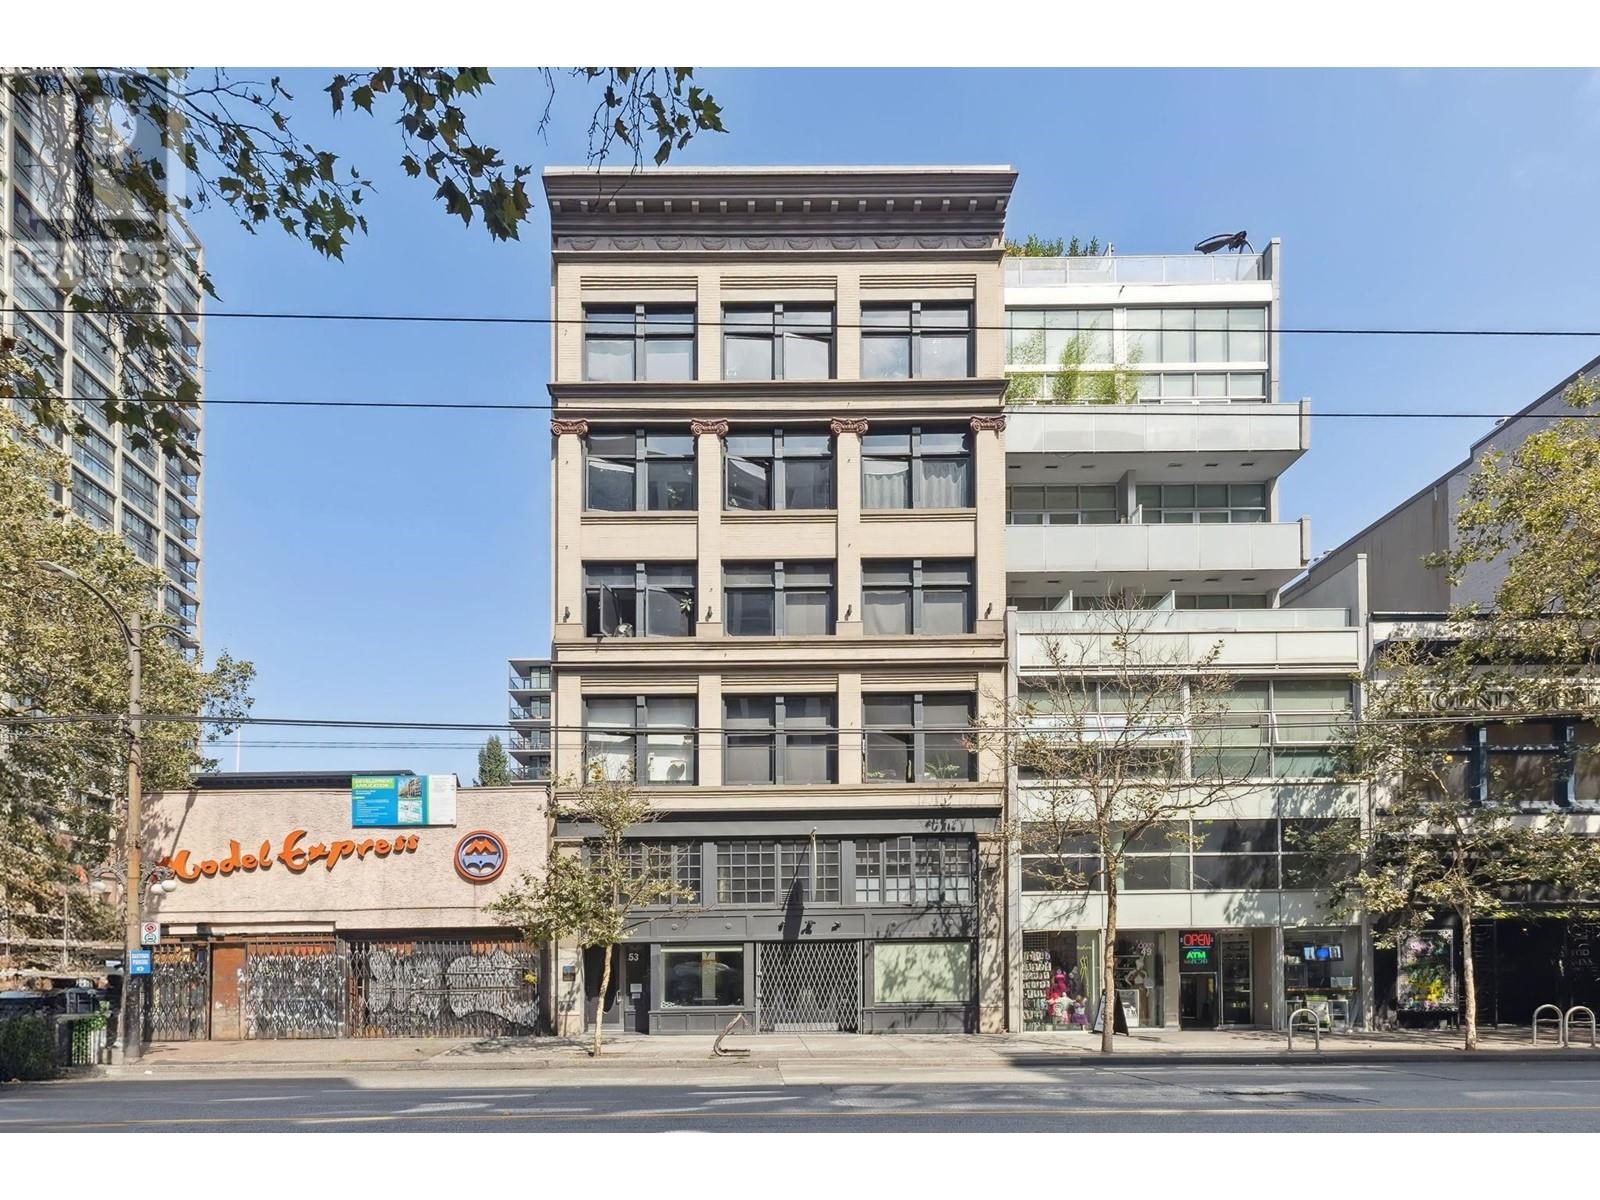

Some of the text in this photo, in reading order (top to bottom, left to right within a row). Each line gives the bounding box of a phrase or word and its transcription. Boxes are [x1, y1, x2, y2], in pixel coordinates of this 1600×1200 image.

[277, 829, 420, 872] Express
[1183, 934, 1212, 946] OPEN
[628, 952, 639, 961] 53
[1186, 951, 1207, 960] ATM
